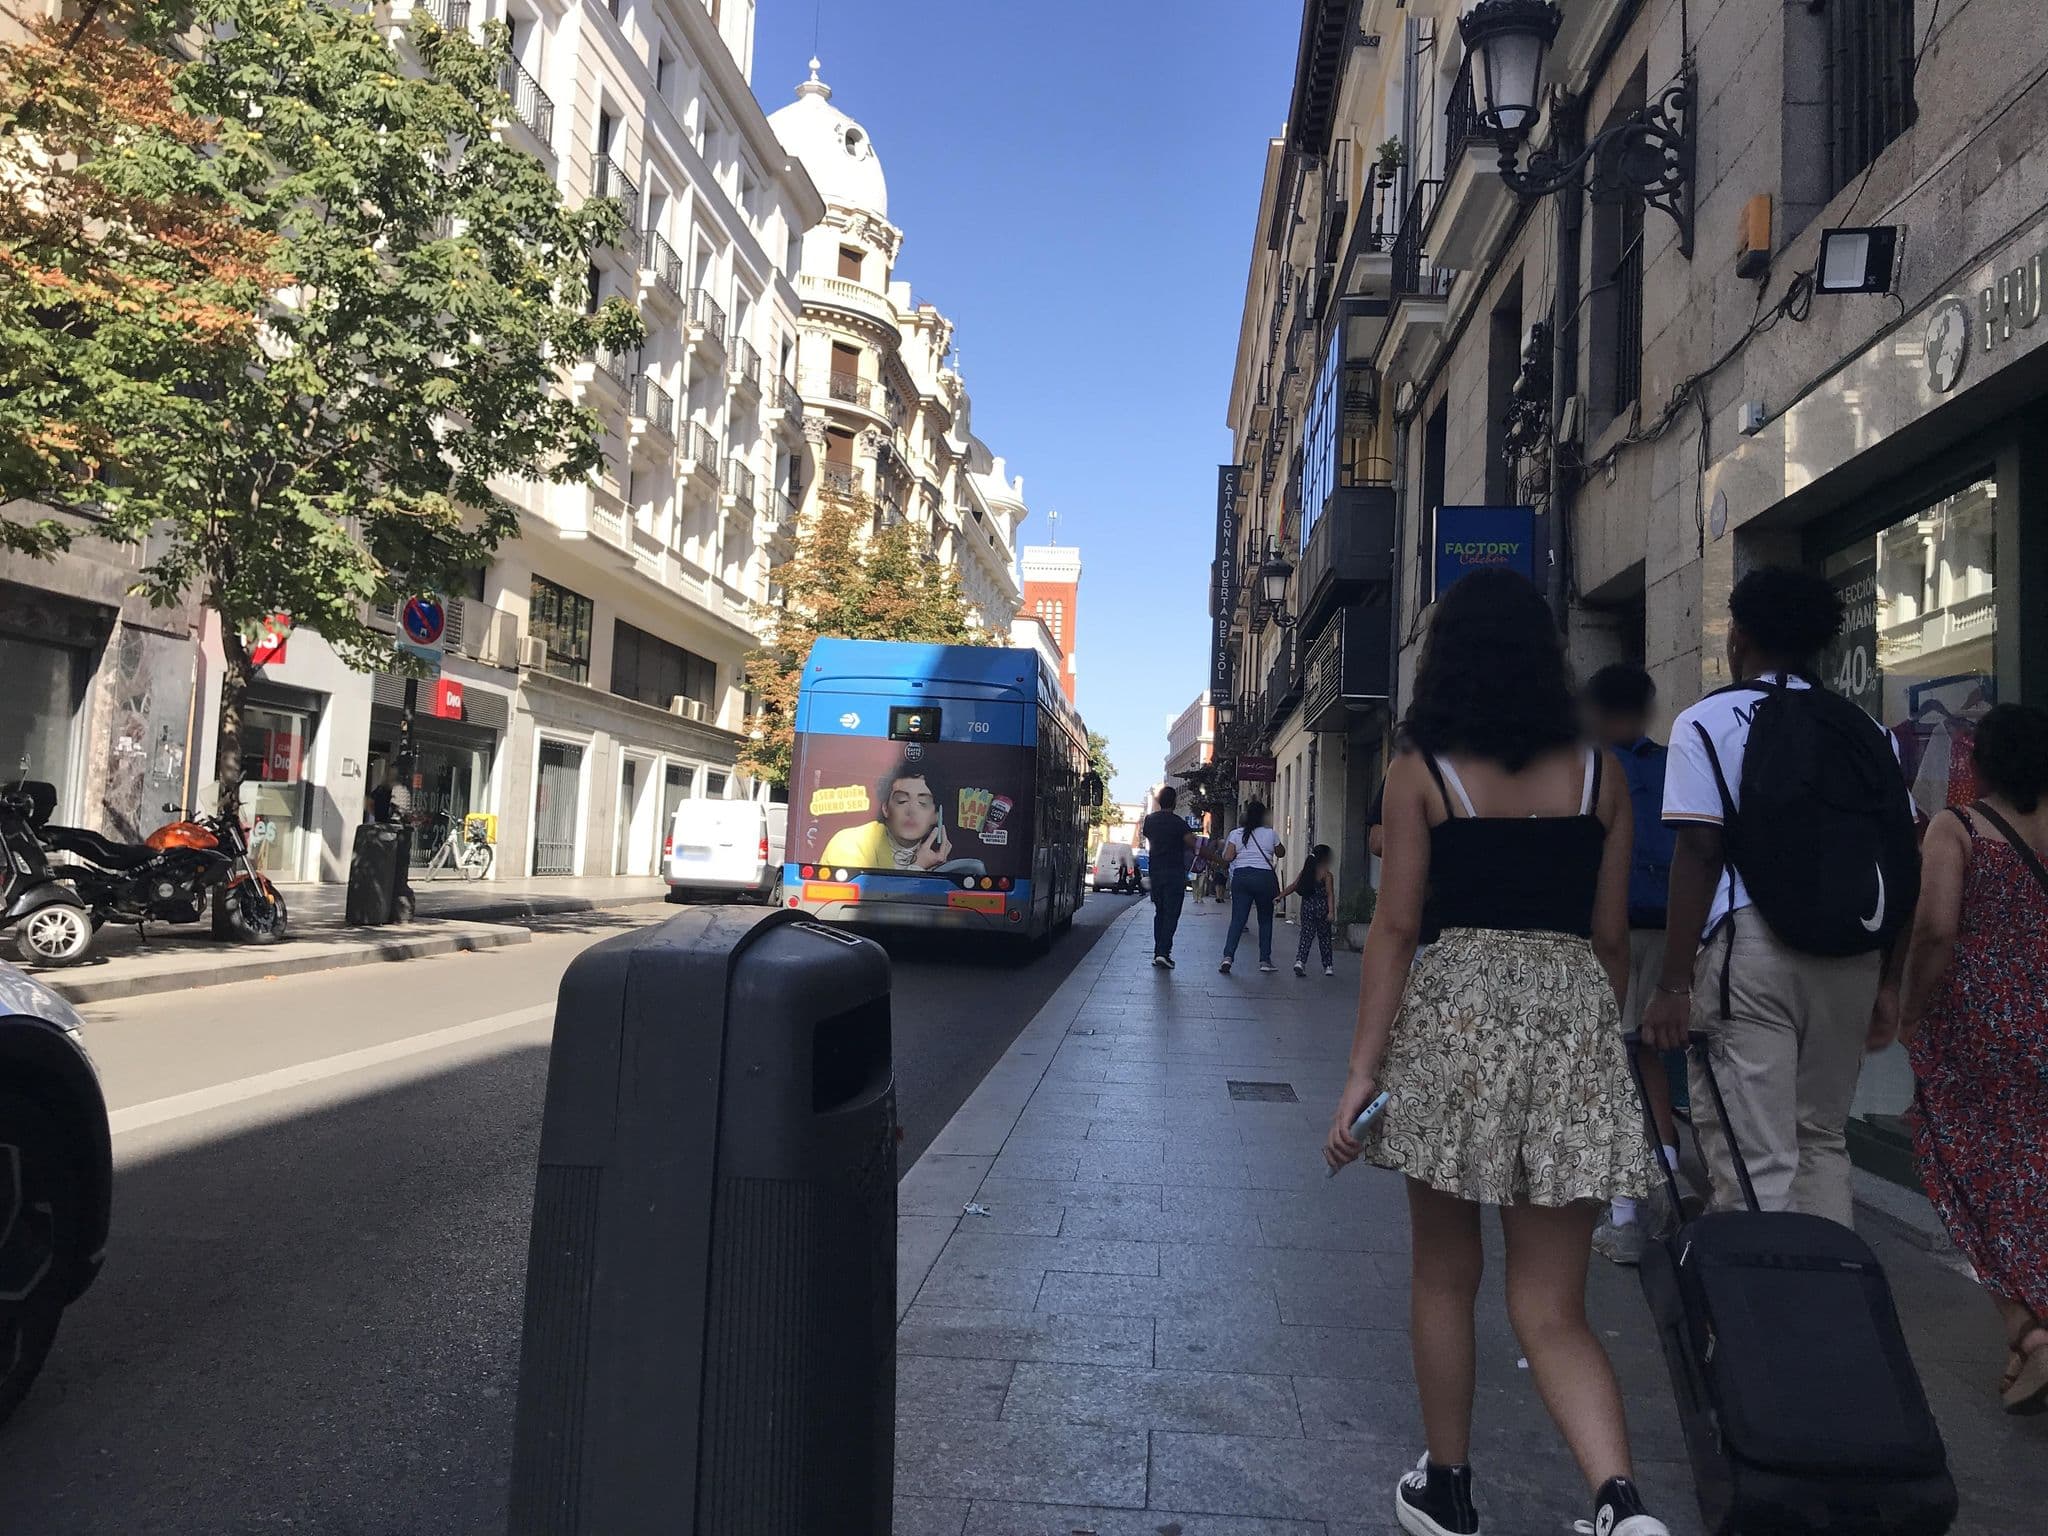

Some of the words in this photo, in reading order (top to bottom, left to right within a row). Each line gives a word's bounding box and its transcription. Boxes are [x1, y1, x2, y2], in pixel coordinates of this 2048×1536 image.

[1980, 252, 2048, 352] HU
[1223, 473, 1234, 556] CATALONIA
[1445, 542, 1520, 555] FACTORY
[1220, 560, 1231, 616] PUERTA
[1217, 652, 1227, 680] SOL
[967, 721, 990, 733] 760
